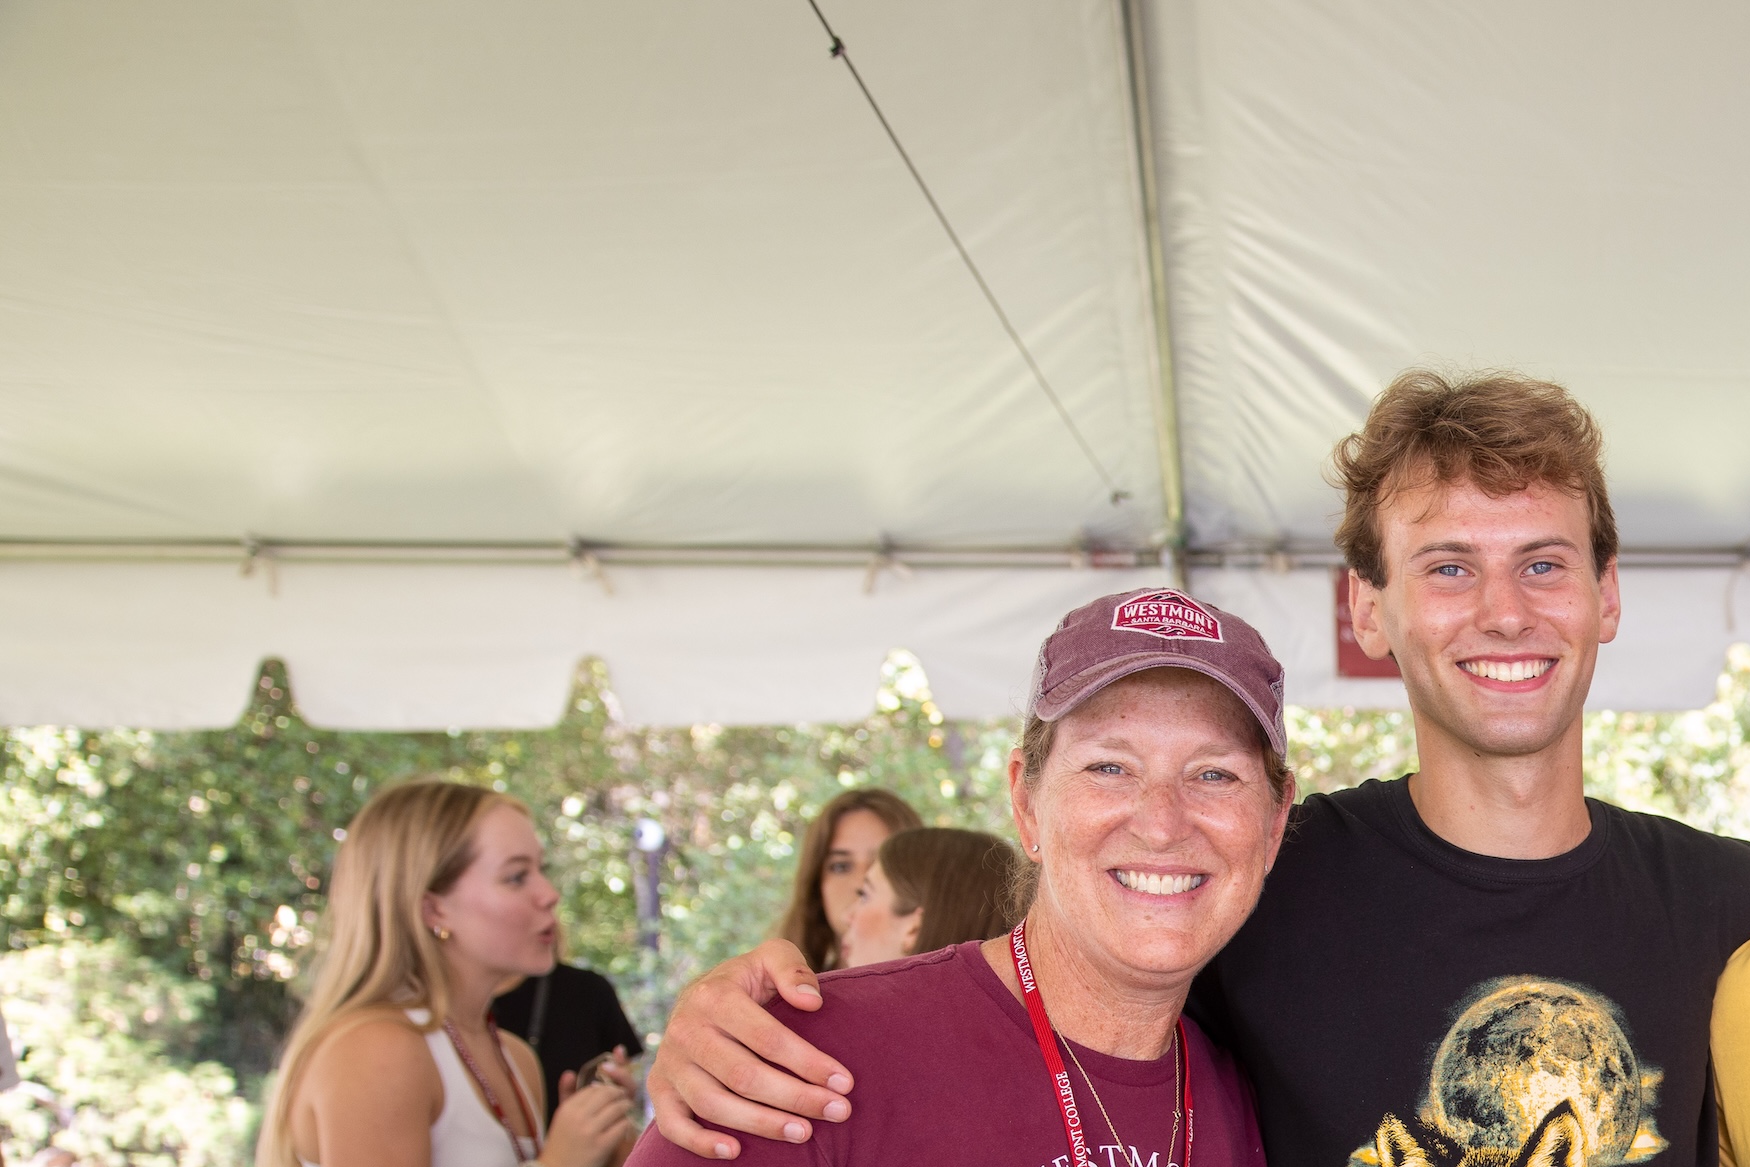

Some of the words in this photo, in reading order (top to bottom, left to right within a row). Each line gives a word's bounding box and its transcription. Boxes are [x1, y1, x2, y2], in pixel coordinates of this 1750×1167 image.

[1124, 604, 1214, 630] WESTMONT
[1131, 616, 1160, 624] SANTA
[1162, 616, 1205, 633] BARBARA
[1013, 935, 1036, 993] WESTMONT
[1056, 1071, 1081, 1127] COLLEGE
